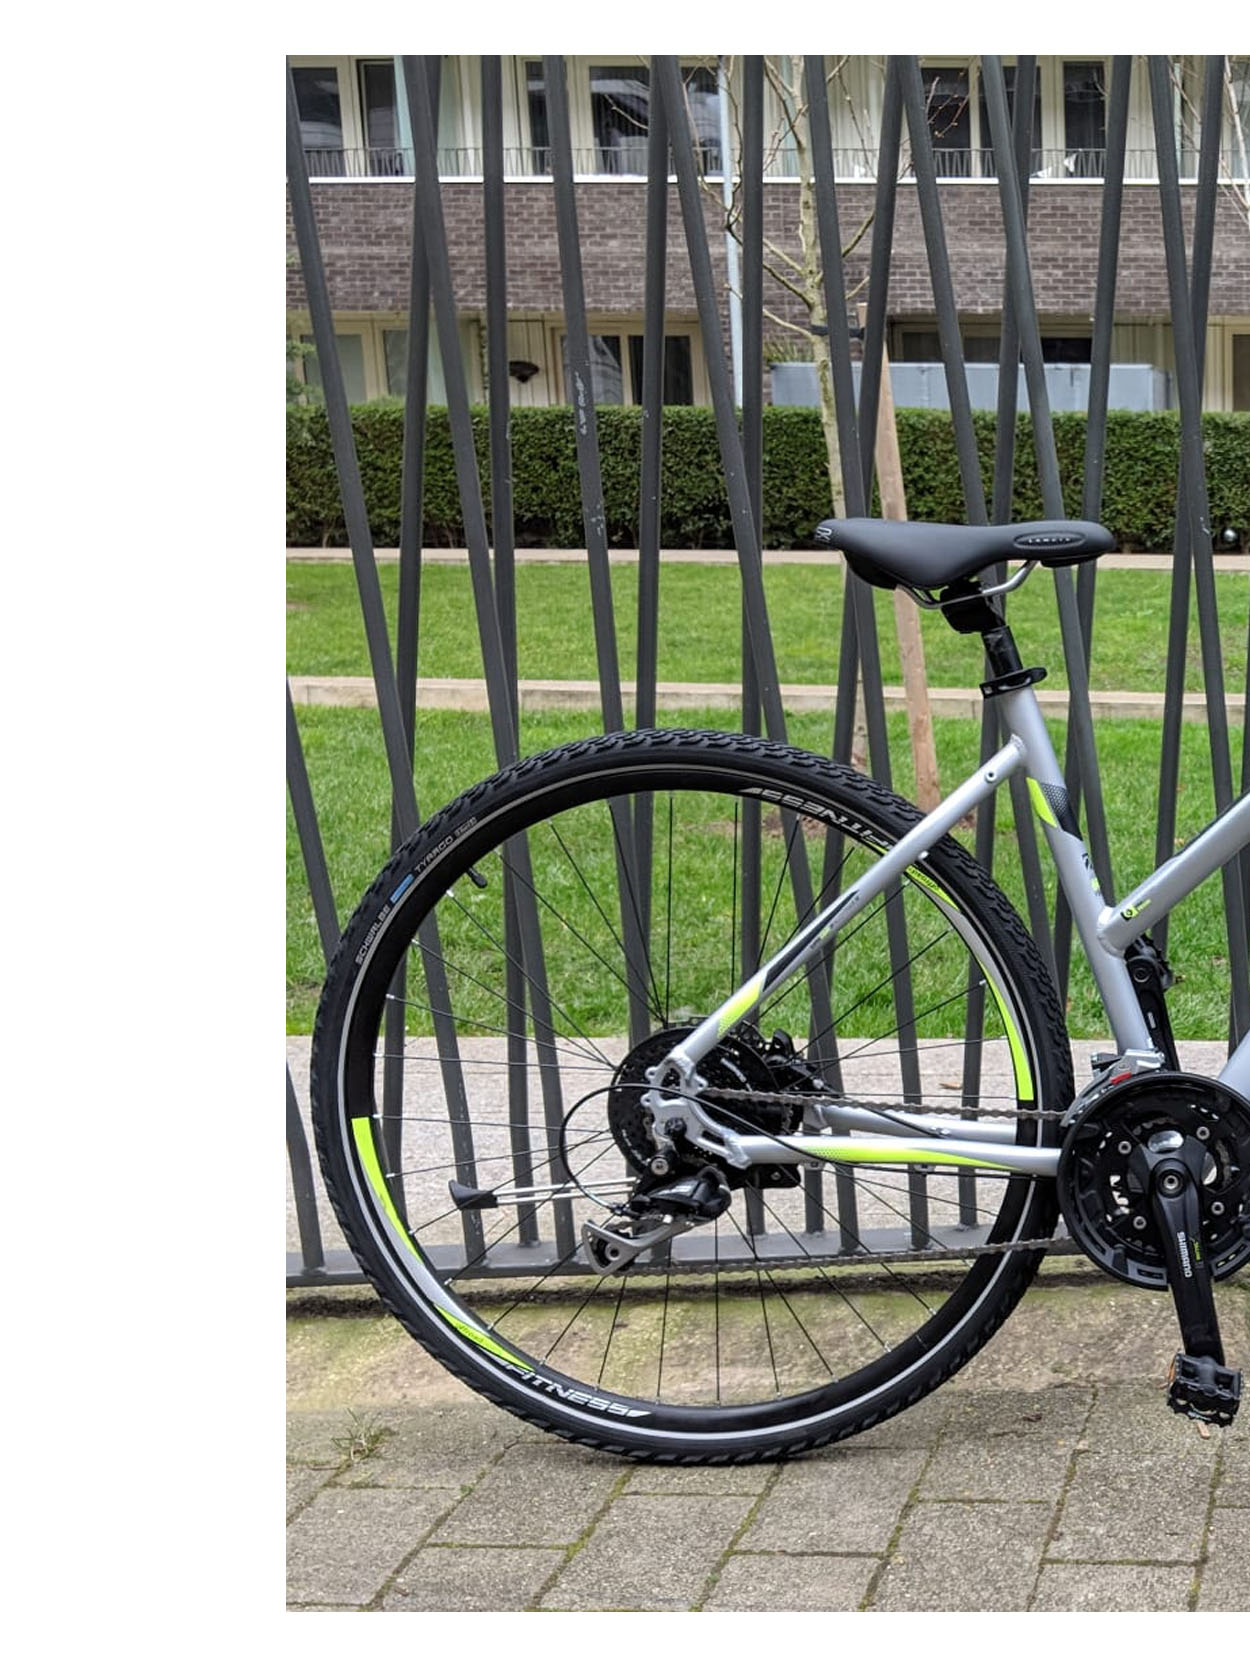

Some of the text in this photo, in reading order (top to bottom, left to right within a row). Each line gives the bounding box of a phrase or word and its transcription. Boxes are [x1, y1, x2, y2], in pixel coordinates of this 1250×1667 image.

[761, 788, 889, 849] FITNESS
[354, 904, 391, 966] SCHWALBE
[1176, 1231, 1193, 1278] SHIMANO
[503, 1361, 633, 1417] FITNESS
